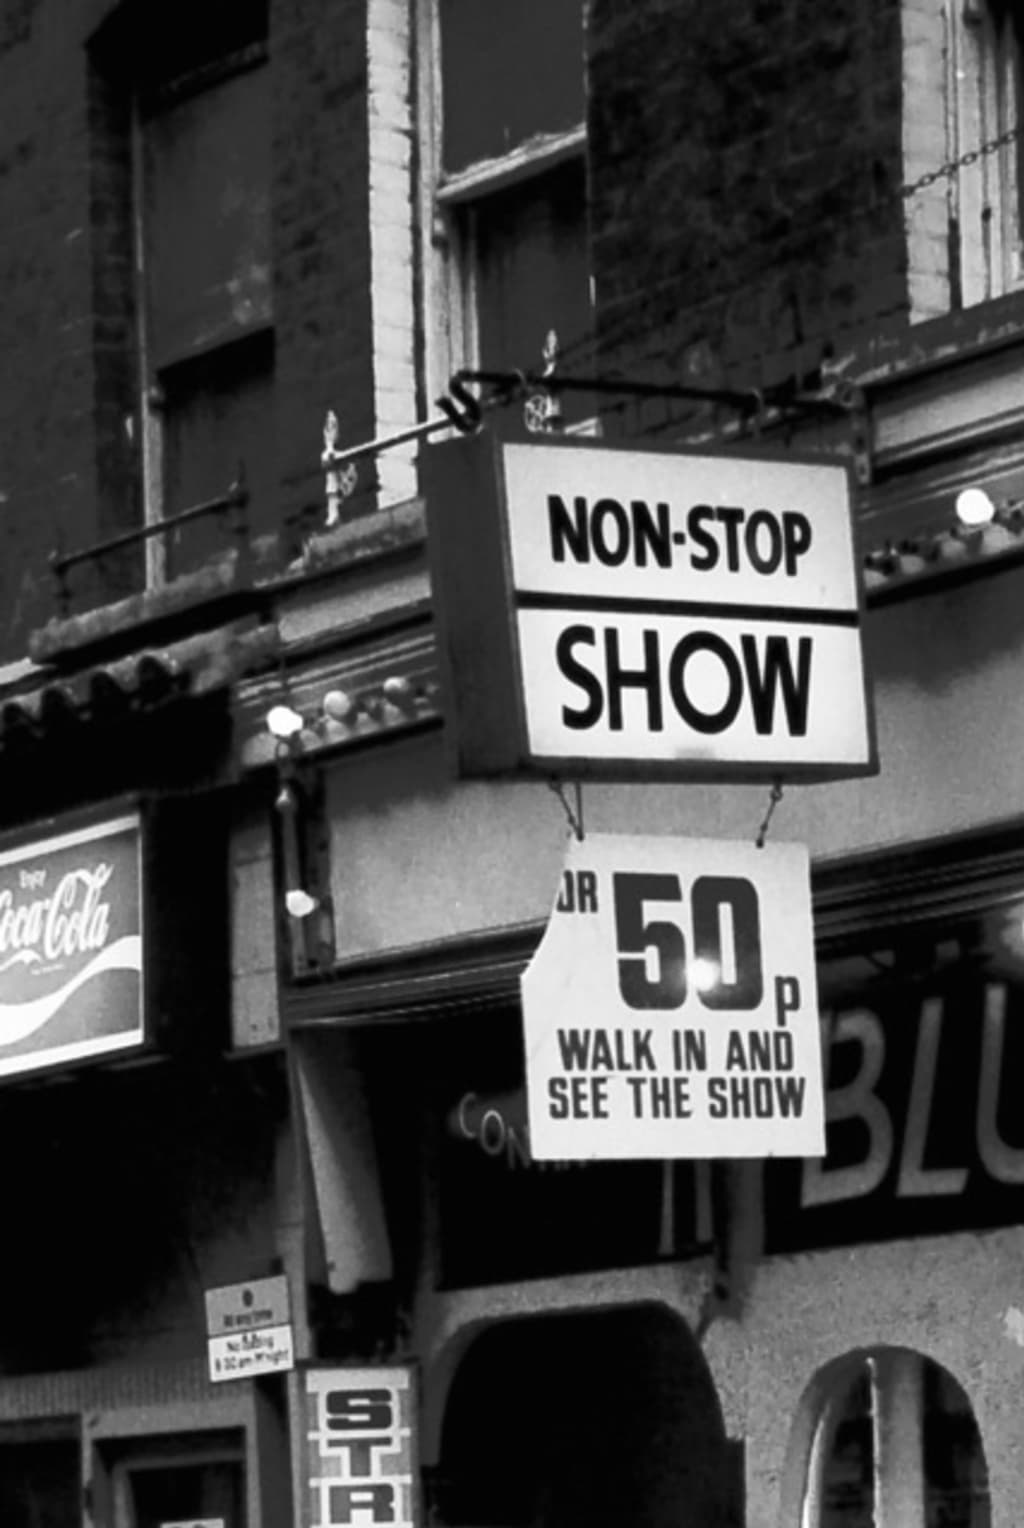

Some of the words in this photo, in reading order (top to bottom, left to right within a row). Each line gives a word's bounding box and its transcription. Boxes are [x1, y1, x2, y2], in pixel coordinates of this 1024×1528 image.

[547, 494, 812, 577] NON-STOP
[555, 624, 812, 737] SHOW
[557, 1028, 656, 1071] WALK
[673, 1029, 707, 1071] IN
[726, 1030, 794, 1071] AND
[548, 1077, 609, 1119] SEE
[626, 1077, 692, 1119] THE
[707, 1077, 805, 1119] SHOW
